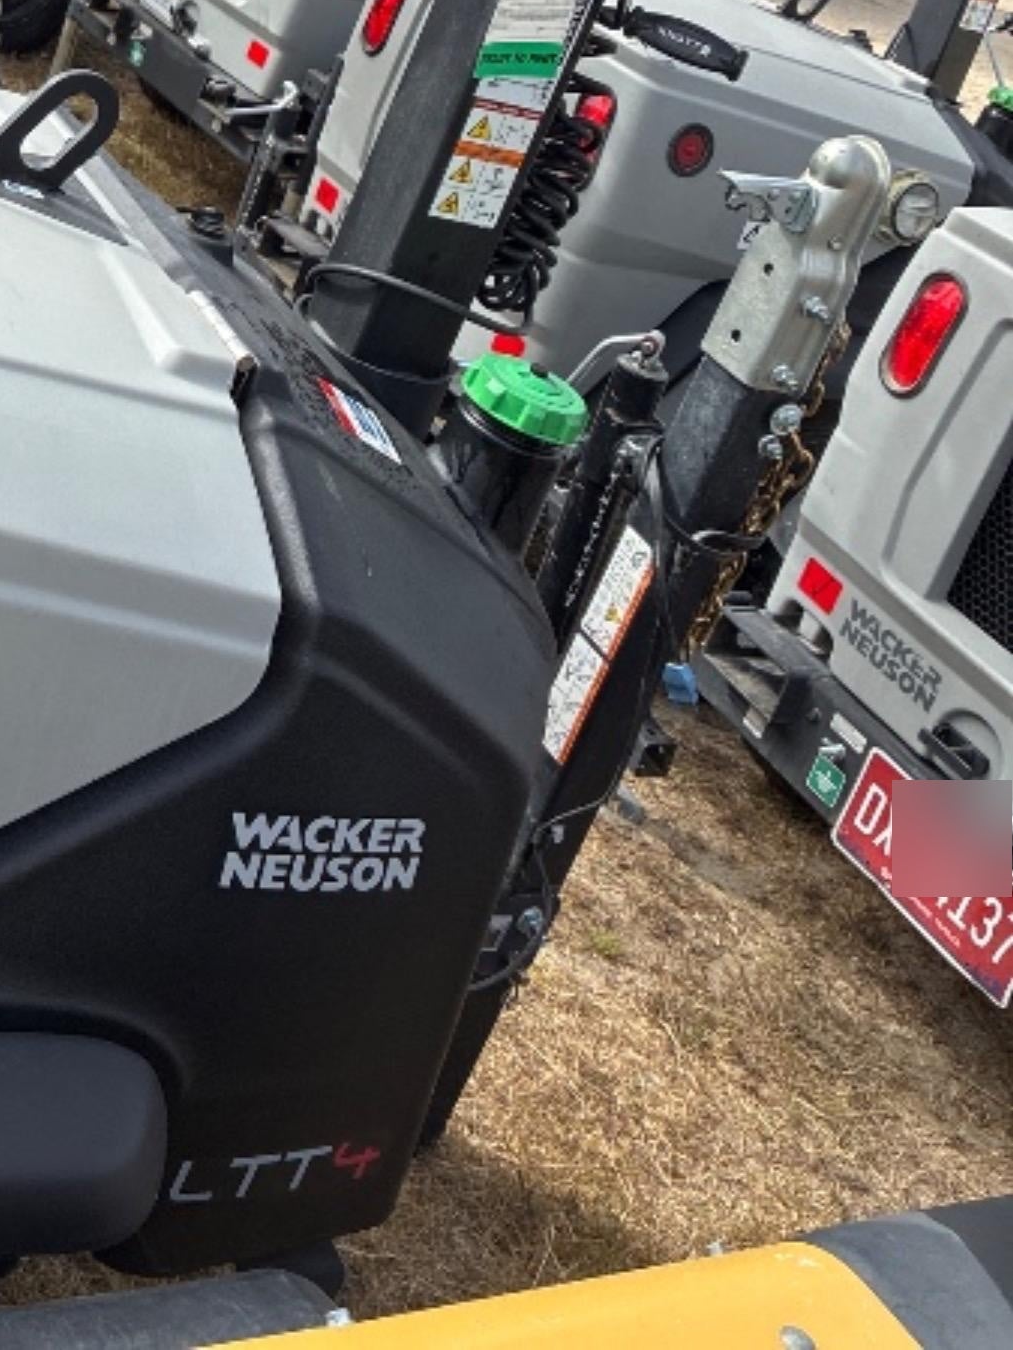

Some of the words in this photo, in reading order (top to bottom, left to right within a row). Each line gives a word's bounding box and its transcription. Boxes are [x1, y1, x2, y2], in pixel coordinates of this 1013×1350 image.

[839, 617, 936, 713] NEUSON
[850, 600, 942, 692] WACKER
[232, 812, 427, 853] WACKER
[219, 850, 420, 892] NEUSON
